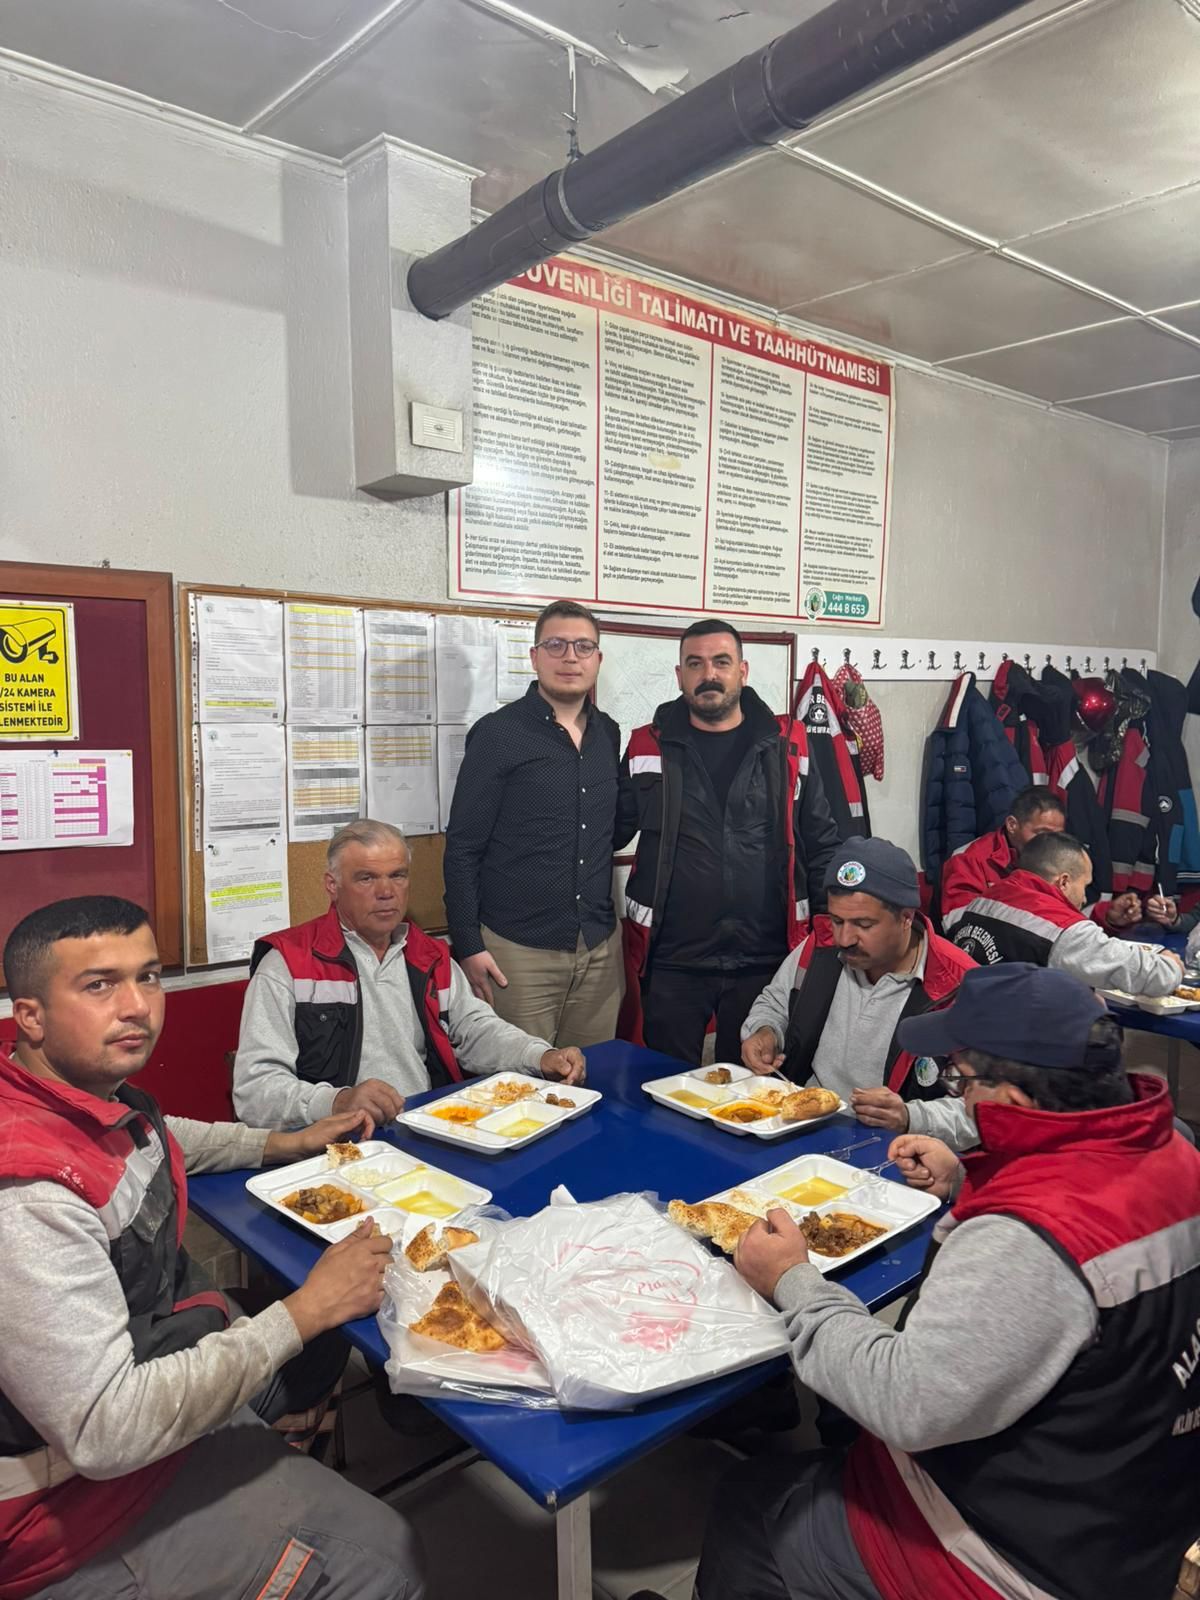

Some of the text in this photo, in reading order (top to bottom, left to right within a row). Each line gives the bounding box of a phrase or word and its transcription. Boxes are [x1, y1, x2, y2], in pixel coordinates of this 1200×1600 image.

[517, 263, 632, 308] ÜVENLİĞİ
[638, 291, 724, 337] TALİMATI
[728, 321, 750, 347] VE
[754, 330, 881, 386] TAAHHÜTNAMESİ
[828, 602, 866, 615] 444 8 653
[5, 673, 44, 683] BU ALAN
[17, 688, 56, 697] KAMERA
[0, 700, 53, 712] SİSTEMİ İLE
[970, 925, 1004, 965] BELEDİYESİ
